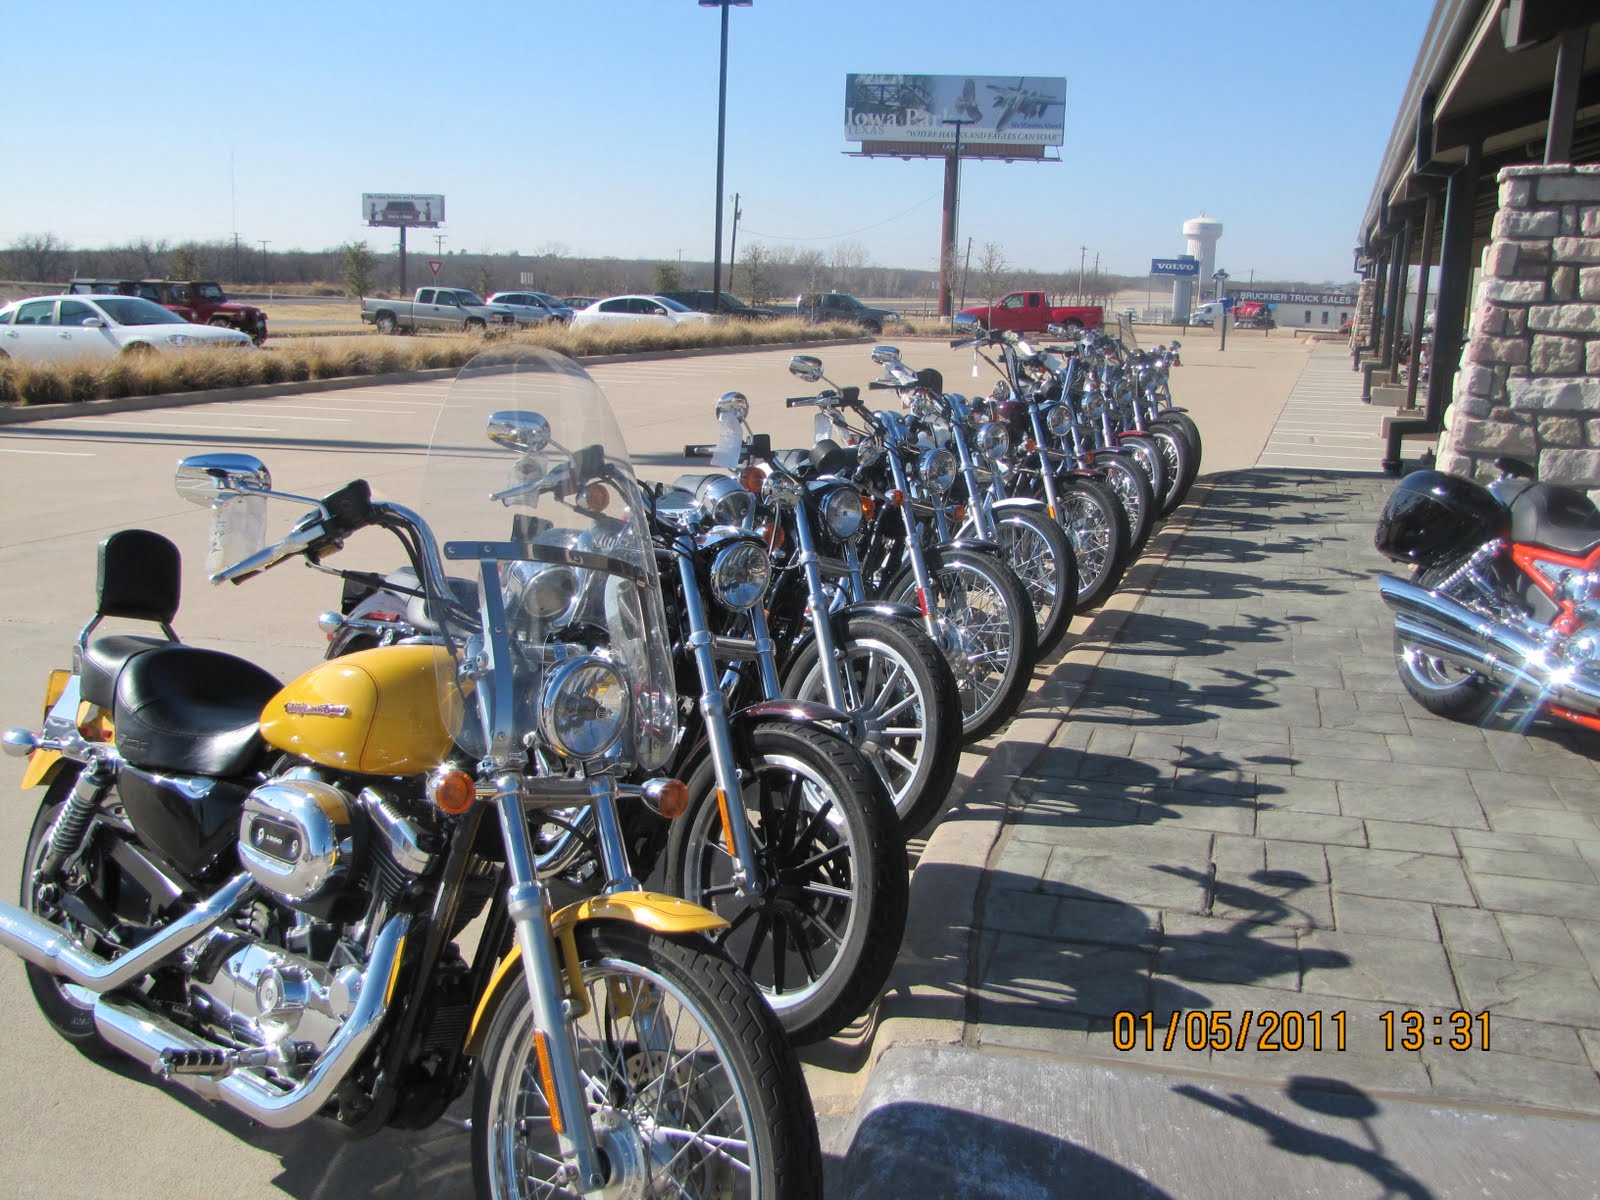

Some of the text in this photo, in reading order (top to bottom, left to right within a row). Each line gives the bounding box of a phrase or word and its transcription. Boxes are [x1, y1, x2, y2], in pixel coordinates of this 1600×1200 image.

[847, 107, 897, 126] Iowa
[848, 125, 884, 135] TEXAS
[968, 131, 987, 139] AND
[987, 132, 1017, 140] EAGLES
[1156, 263, 1194, 271] VOLVO
[1240, 291, 1352, 304] BRUCKNER TRUCK SALES
